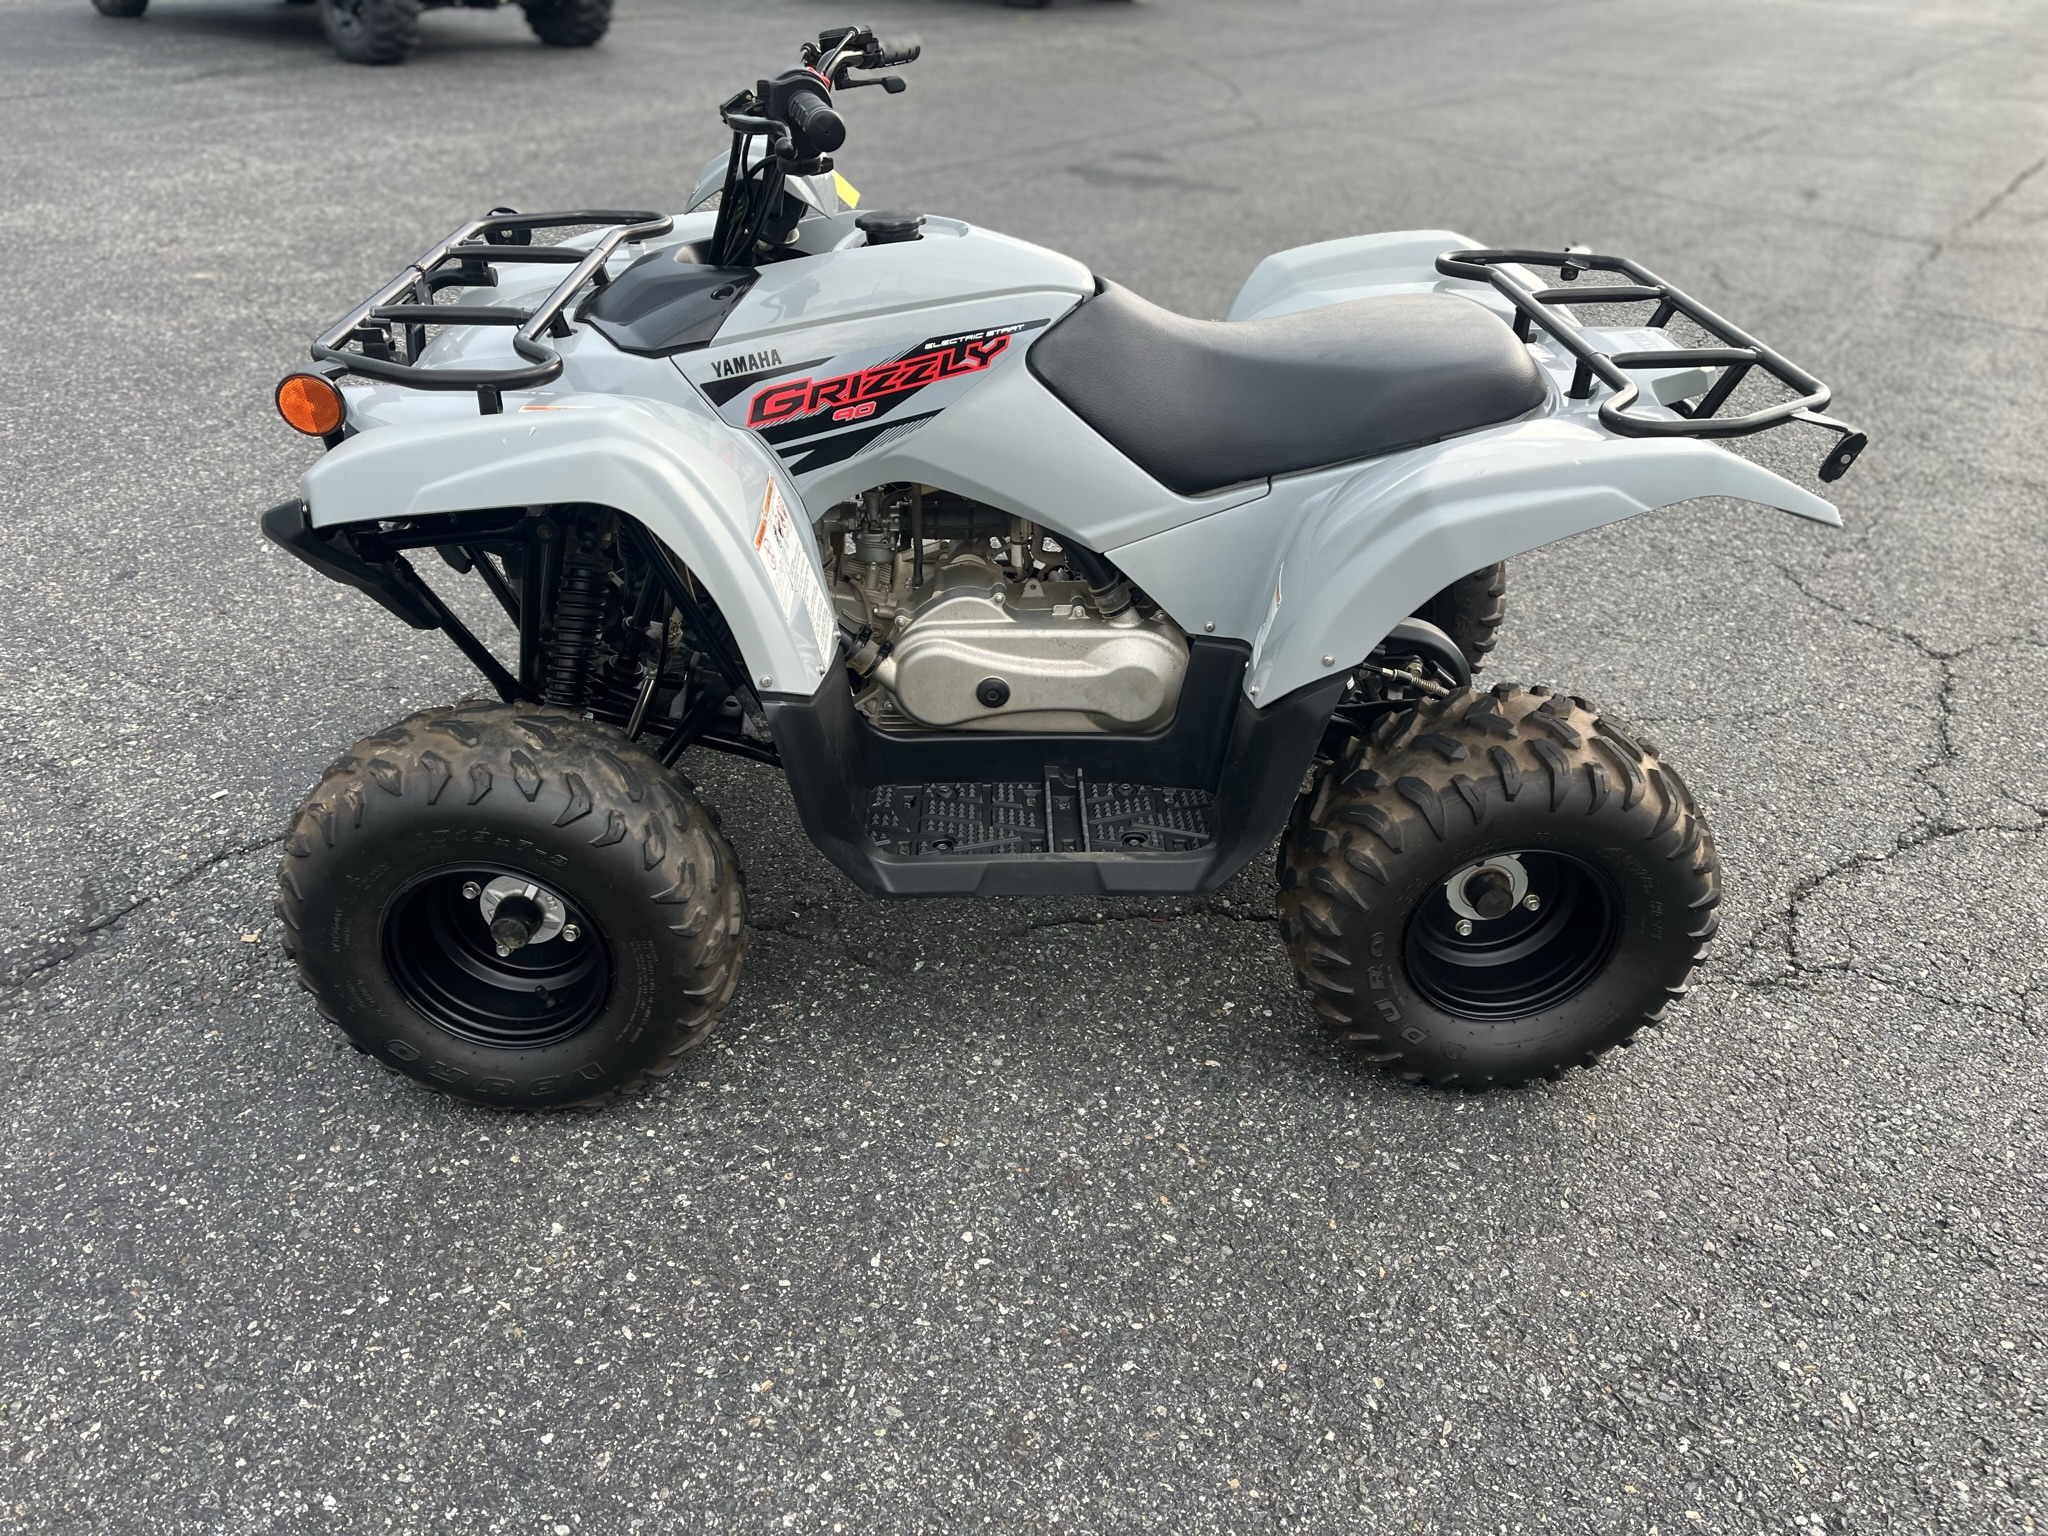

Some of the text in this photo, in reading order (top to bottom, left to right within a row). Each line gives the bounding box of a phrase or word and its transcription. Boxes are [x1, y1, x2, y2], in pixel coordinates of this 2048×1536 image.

[924, 323, 1026, 350] ELECTRIC START
[711, 349, 783, 378] YAMAHA
[746, 334, 1010, 427] GRIZZLY
[832, 401, 877, 421] 90
[1367, 932, 1431, 1046] DURO
